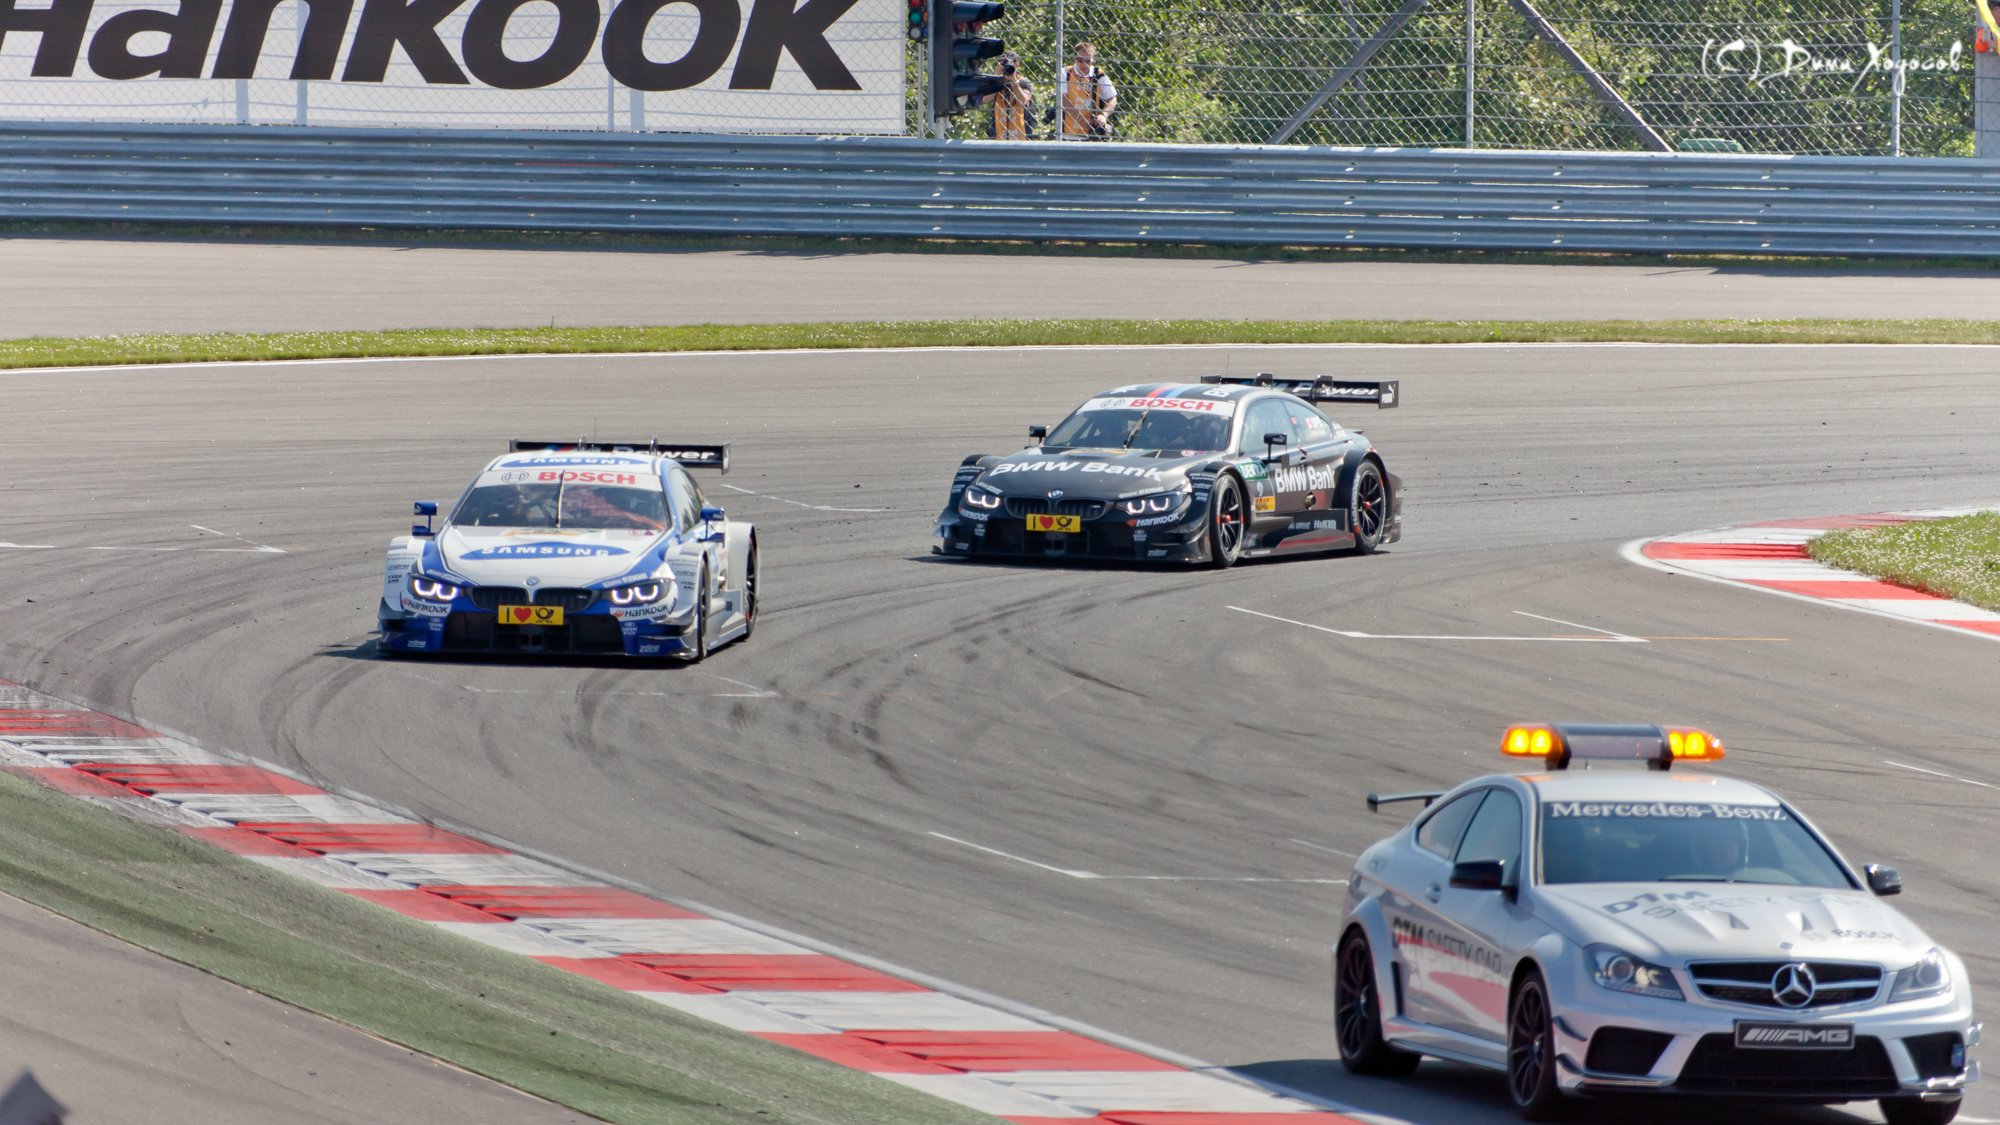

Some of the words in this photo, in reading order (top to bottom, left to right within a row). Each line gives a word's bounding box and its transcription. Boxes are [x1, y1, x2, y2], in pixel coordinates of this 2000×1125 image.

[1129, 398, 1214, 412] BOSCH
[537, 470, 636, 485] BOSCH
[989, 461, 1080, 477] BMW
[1080, 461, 1163, 482] Bank
[1274, 466, 1307, 494] BMW
[1308, 464, 1336, 490] Bank
[1256, 481, 1264, 497] 9
[481, 546, 608, 557] SAMSUNG
[1550, 801, 1788, 821] Mercedes-Benz
[1602, 889, 1711, 914] DTM
[1393, 915, 1424, 948] DTM
[1780, 1028, 1850, 1043] AMG
